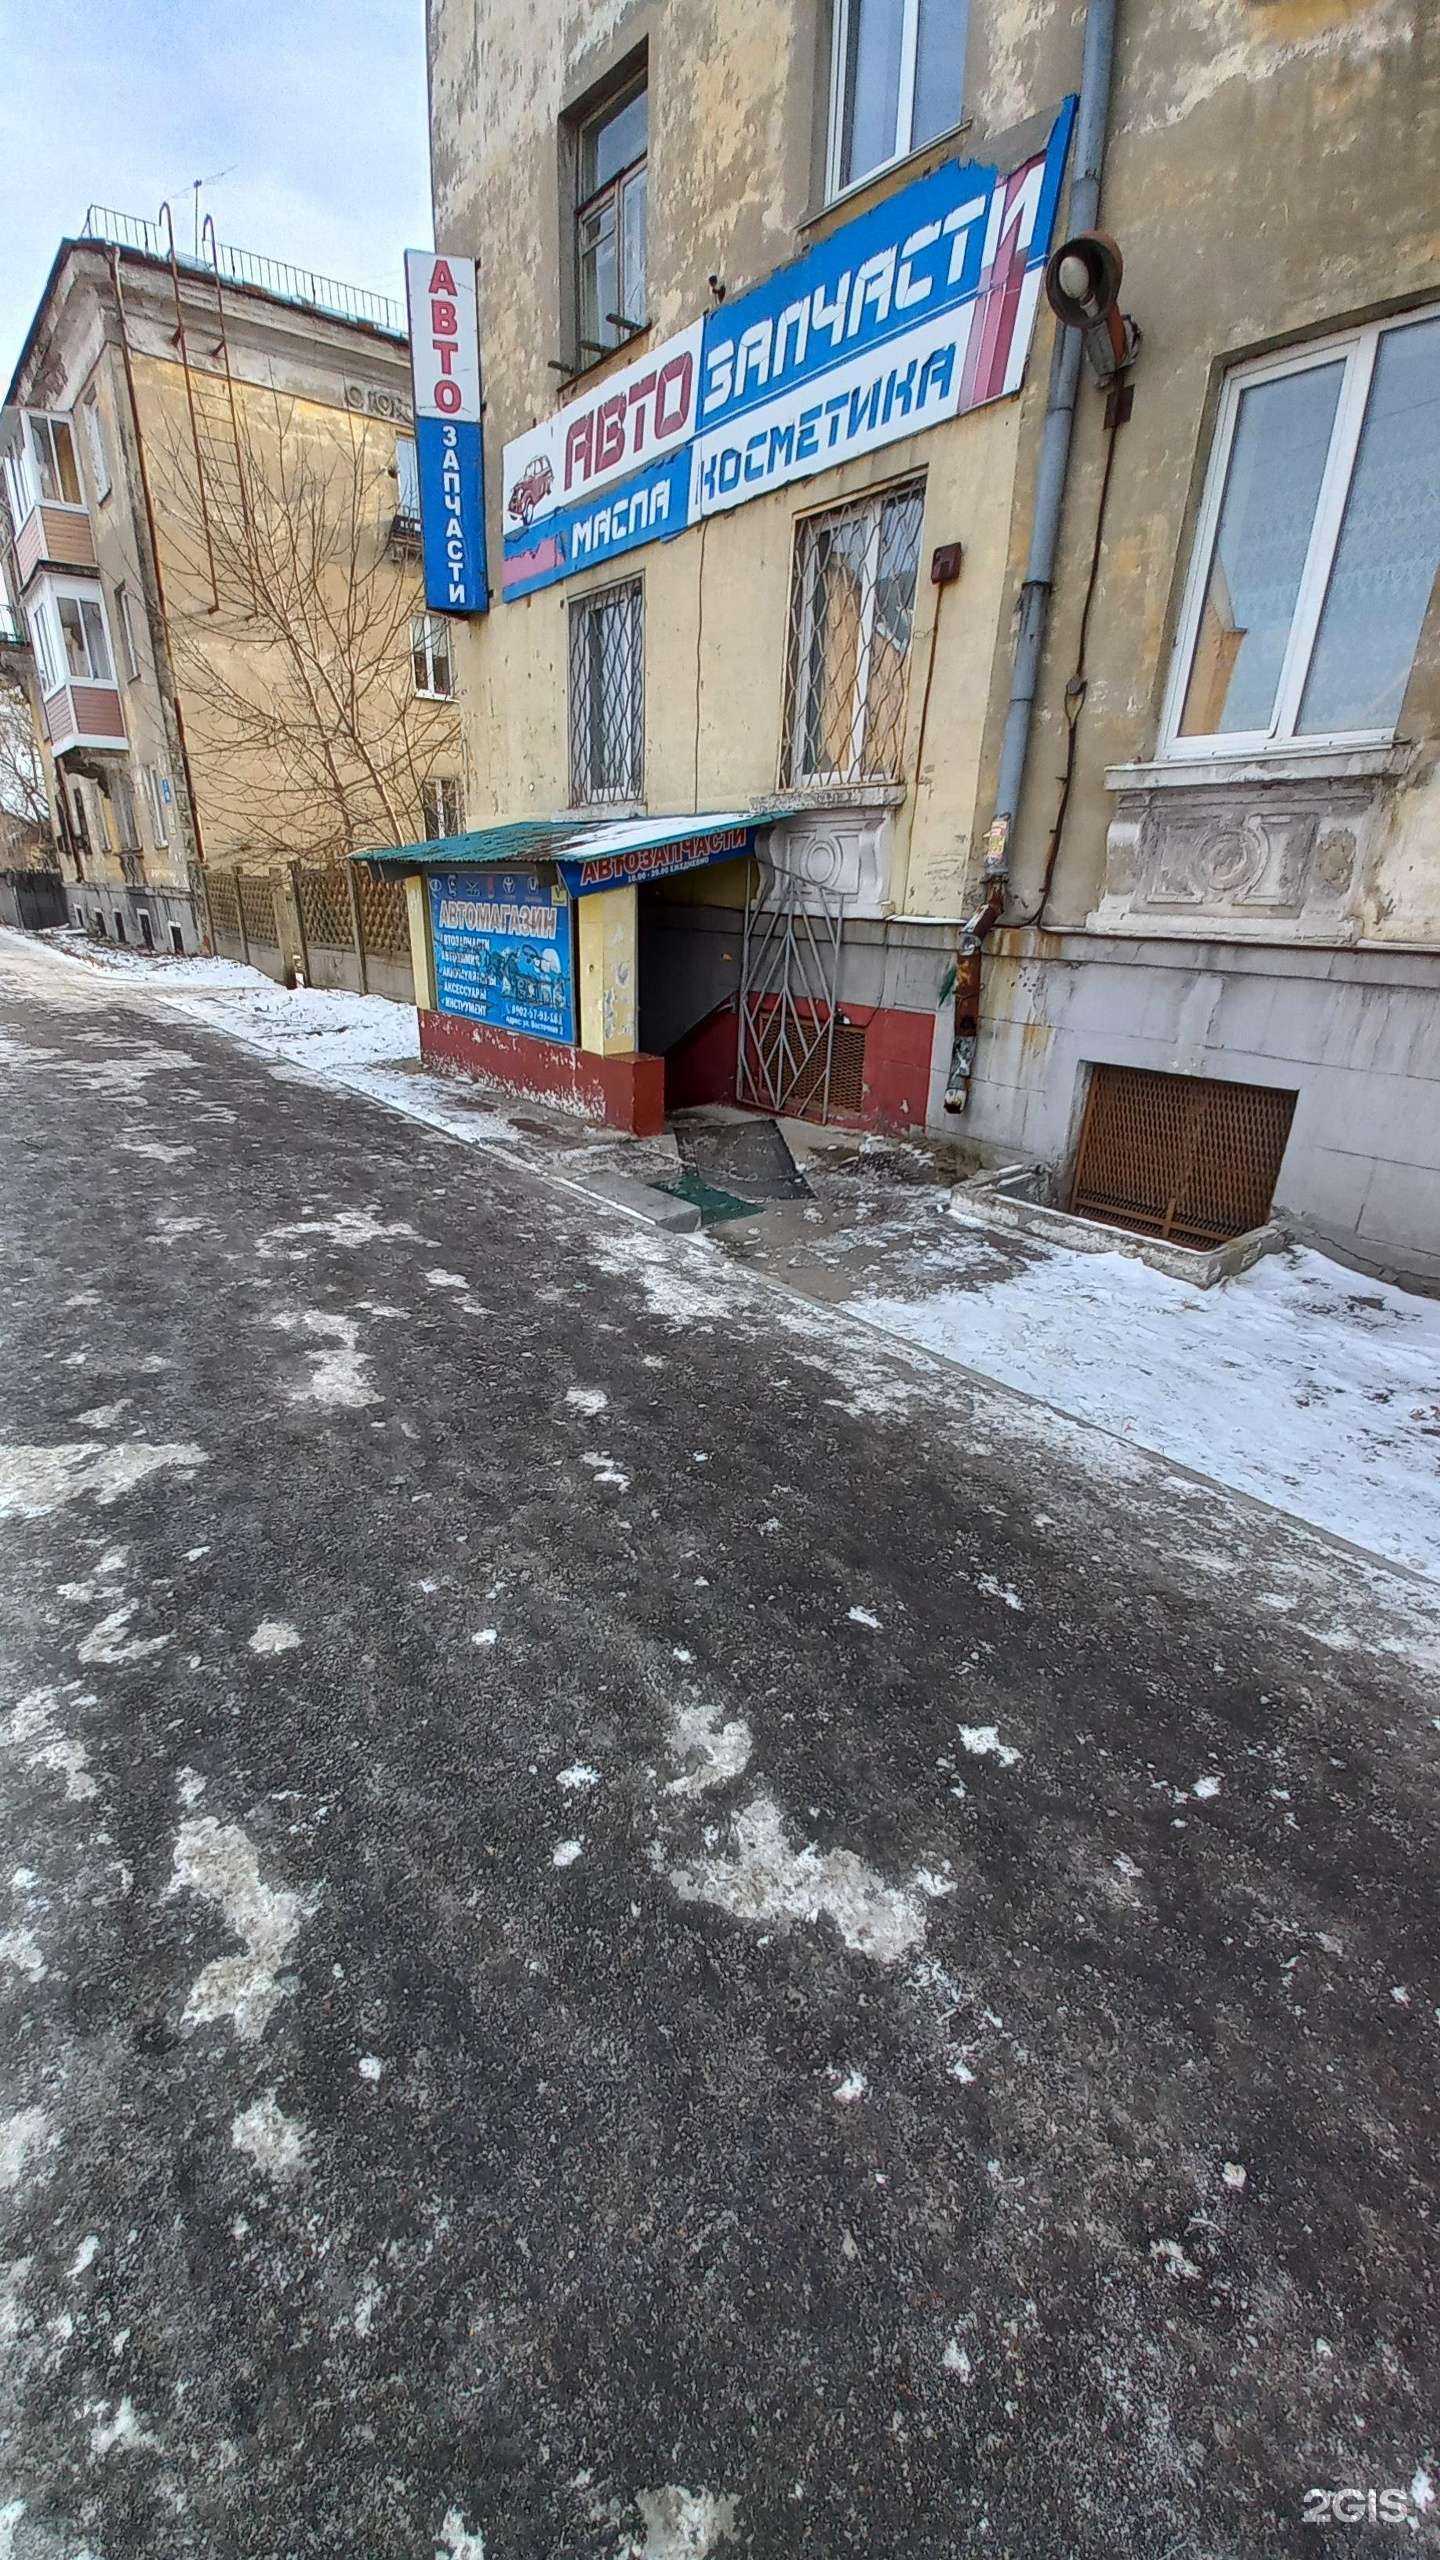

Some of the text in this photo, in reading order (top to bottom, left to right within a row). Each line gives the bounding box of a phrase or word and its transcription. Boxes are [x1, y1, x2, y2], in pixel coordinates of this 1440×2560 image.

[428, 260, 466, 604] АВТО ЗАПЧАСТИ
[564, 161, 1046, 491] АВТО ЗАПЧАСТИ
[571, 342, 957, 559] МАСЛА КОСМЕТИКА
[439, 900, 557, 940] АВТОМАГАЗИН
[580, 828, 747, 886] АВТОЗАПЧАСТИ
